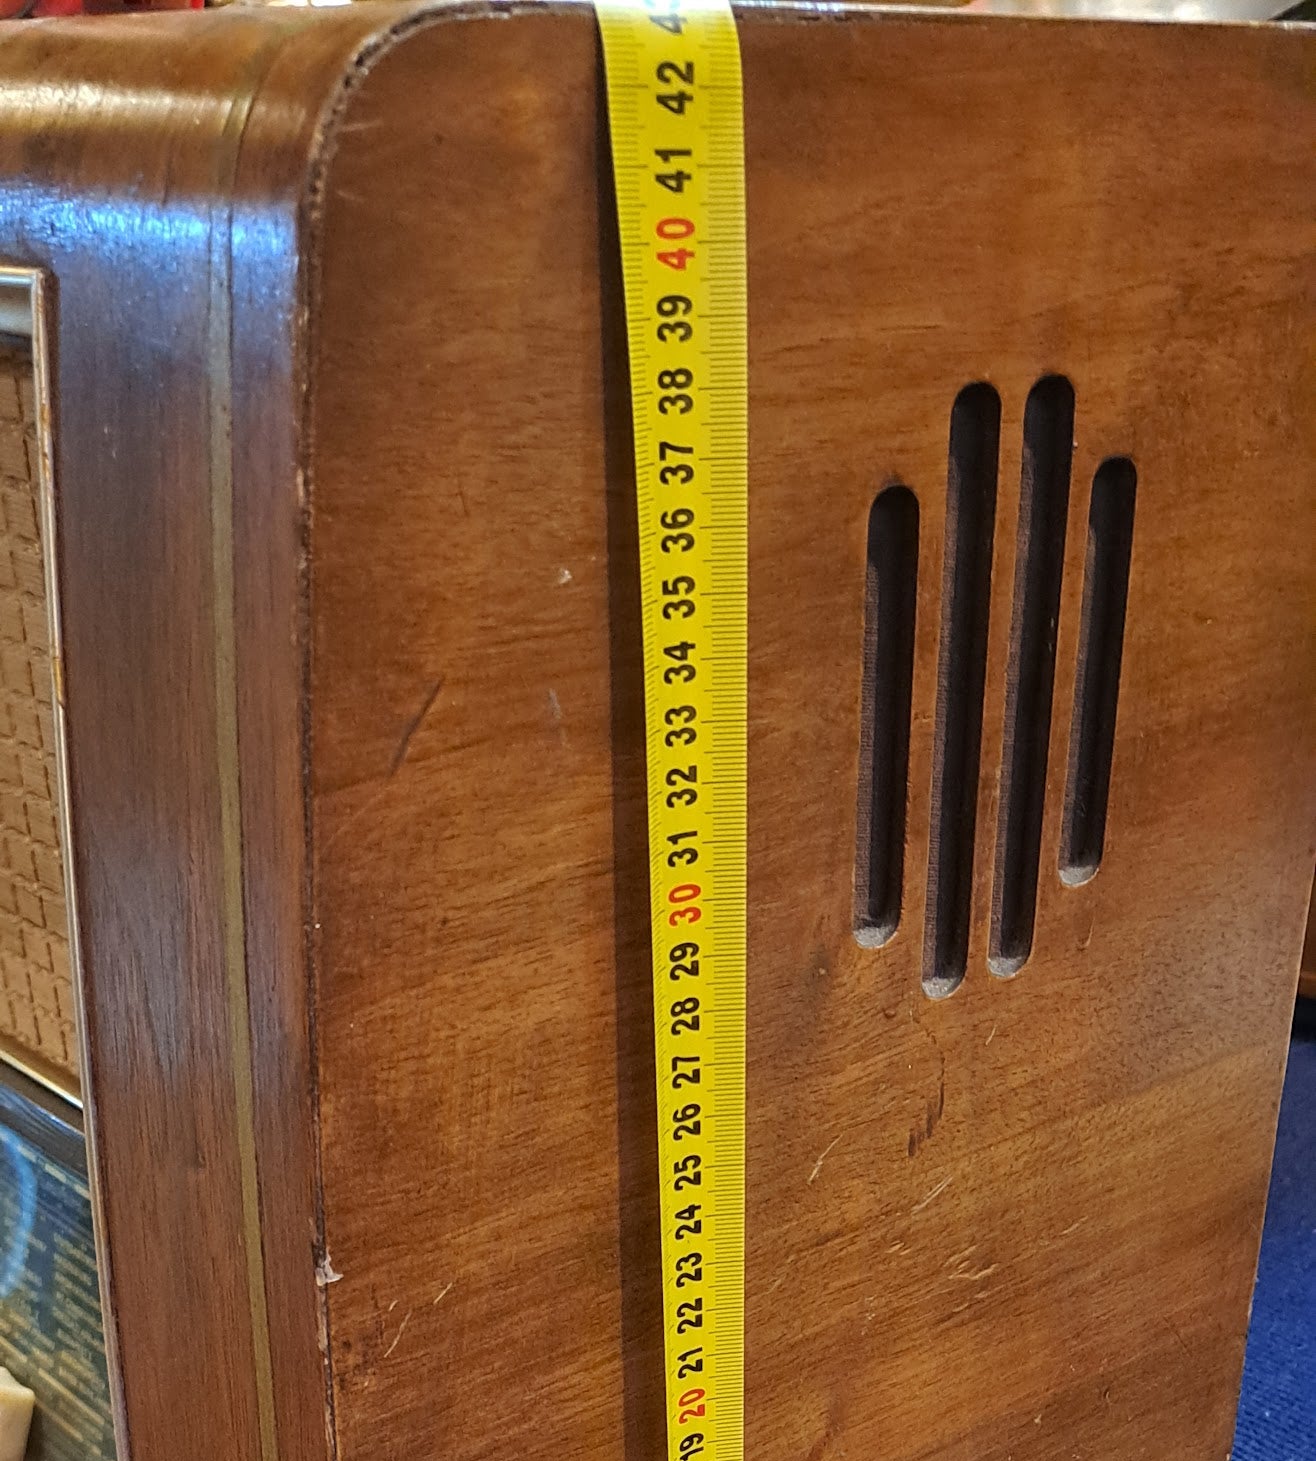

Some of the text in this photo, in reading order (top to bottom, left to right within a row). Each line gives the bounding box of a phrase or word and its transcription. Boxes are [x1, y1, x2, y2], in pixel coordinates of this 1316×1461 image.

[655, 60, 695, 116] 42
[653, 148, 693, 194] 41
[655, 217, 696, 271] 40
[655, 294, 694, 343] 39
[657, 367, 694, 416] 38
[658, 440, 695, 486] 37
[659, 507, 696, 554] 36
[661, 575, 696, 621] 35
[662, 640, 697, 685] 34
[664, 704, 698, 748] 33
[665, 764, 698, 809] 32
[666, 830, 699, 868] 31
[668, 883, 702, 927] 30
[668, 941, 700, 982] 29
[669, 996, 701, 1036] 28
[671, 1055, 701, 1090] 27
[672, 1103, 702, 1142] 26
[673, 1154, 702, 1192] 25
[674, 1203, 702, 1241] 24
[675, 1252, 703, 1289] 23
[676, 1297, 703, 1335] 22
[676, 1346, 704, 1380] 21
[678, 1388, 706, 1425] 20
[678, 1432, 705, 1461] 19
